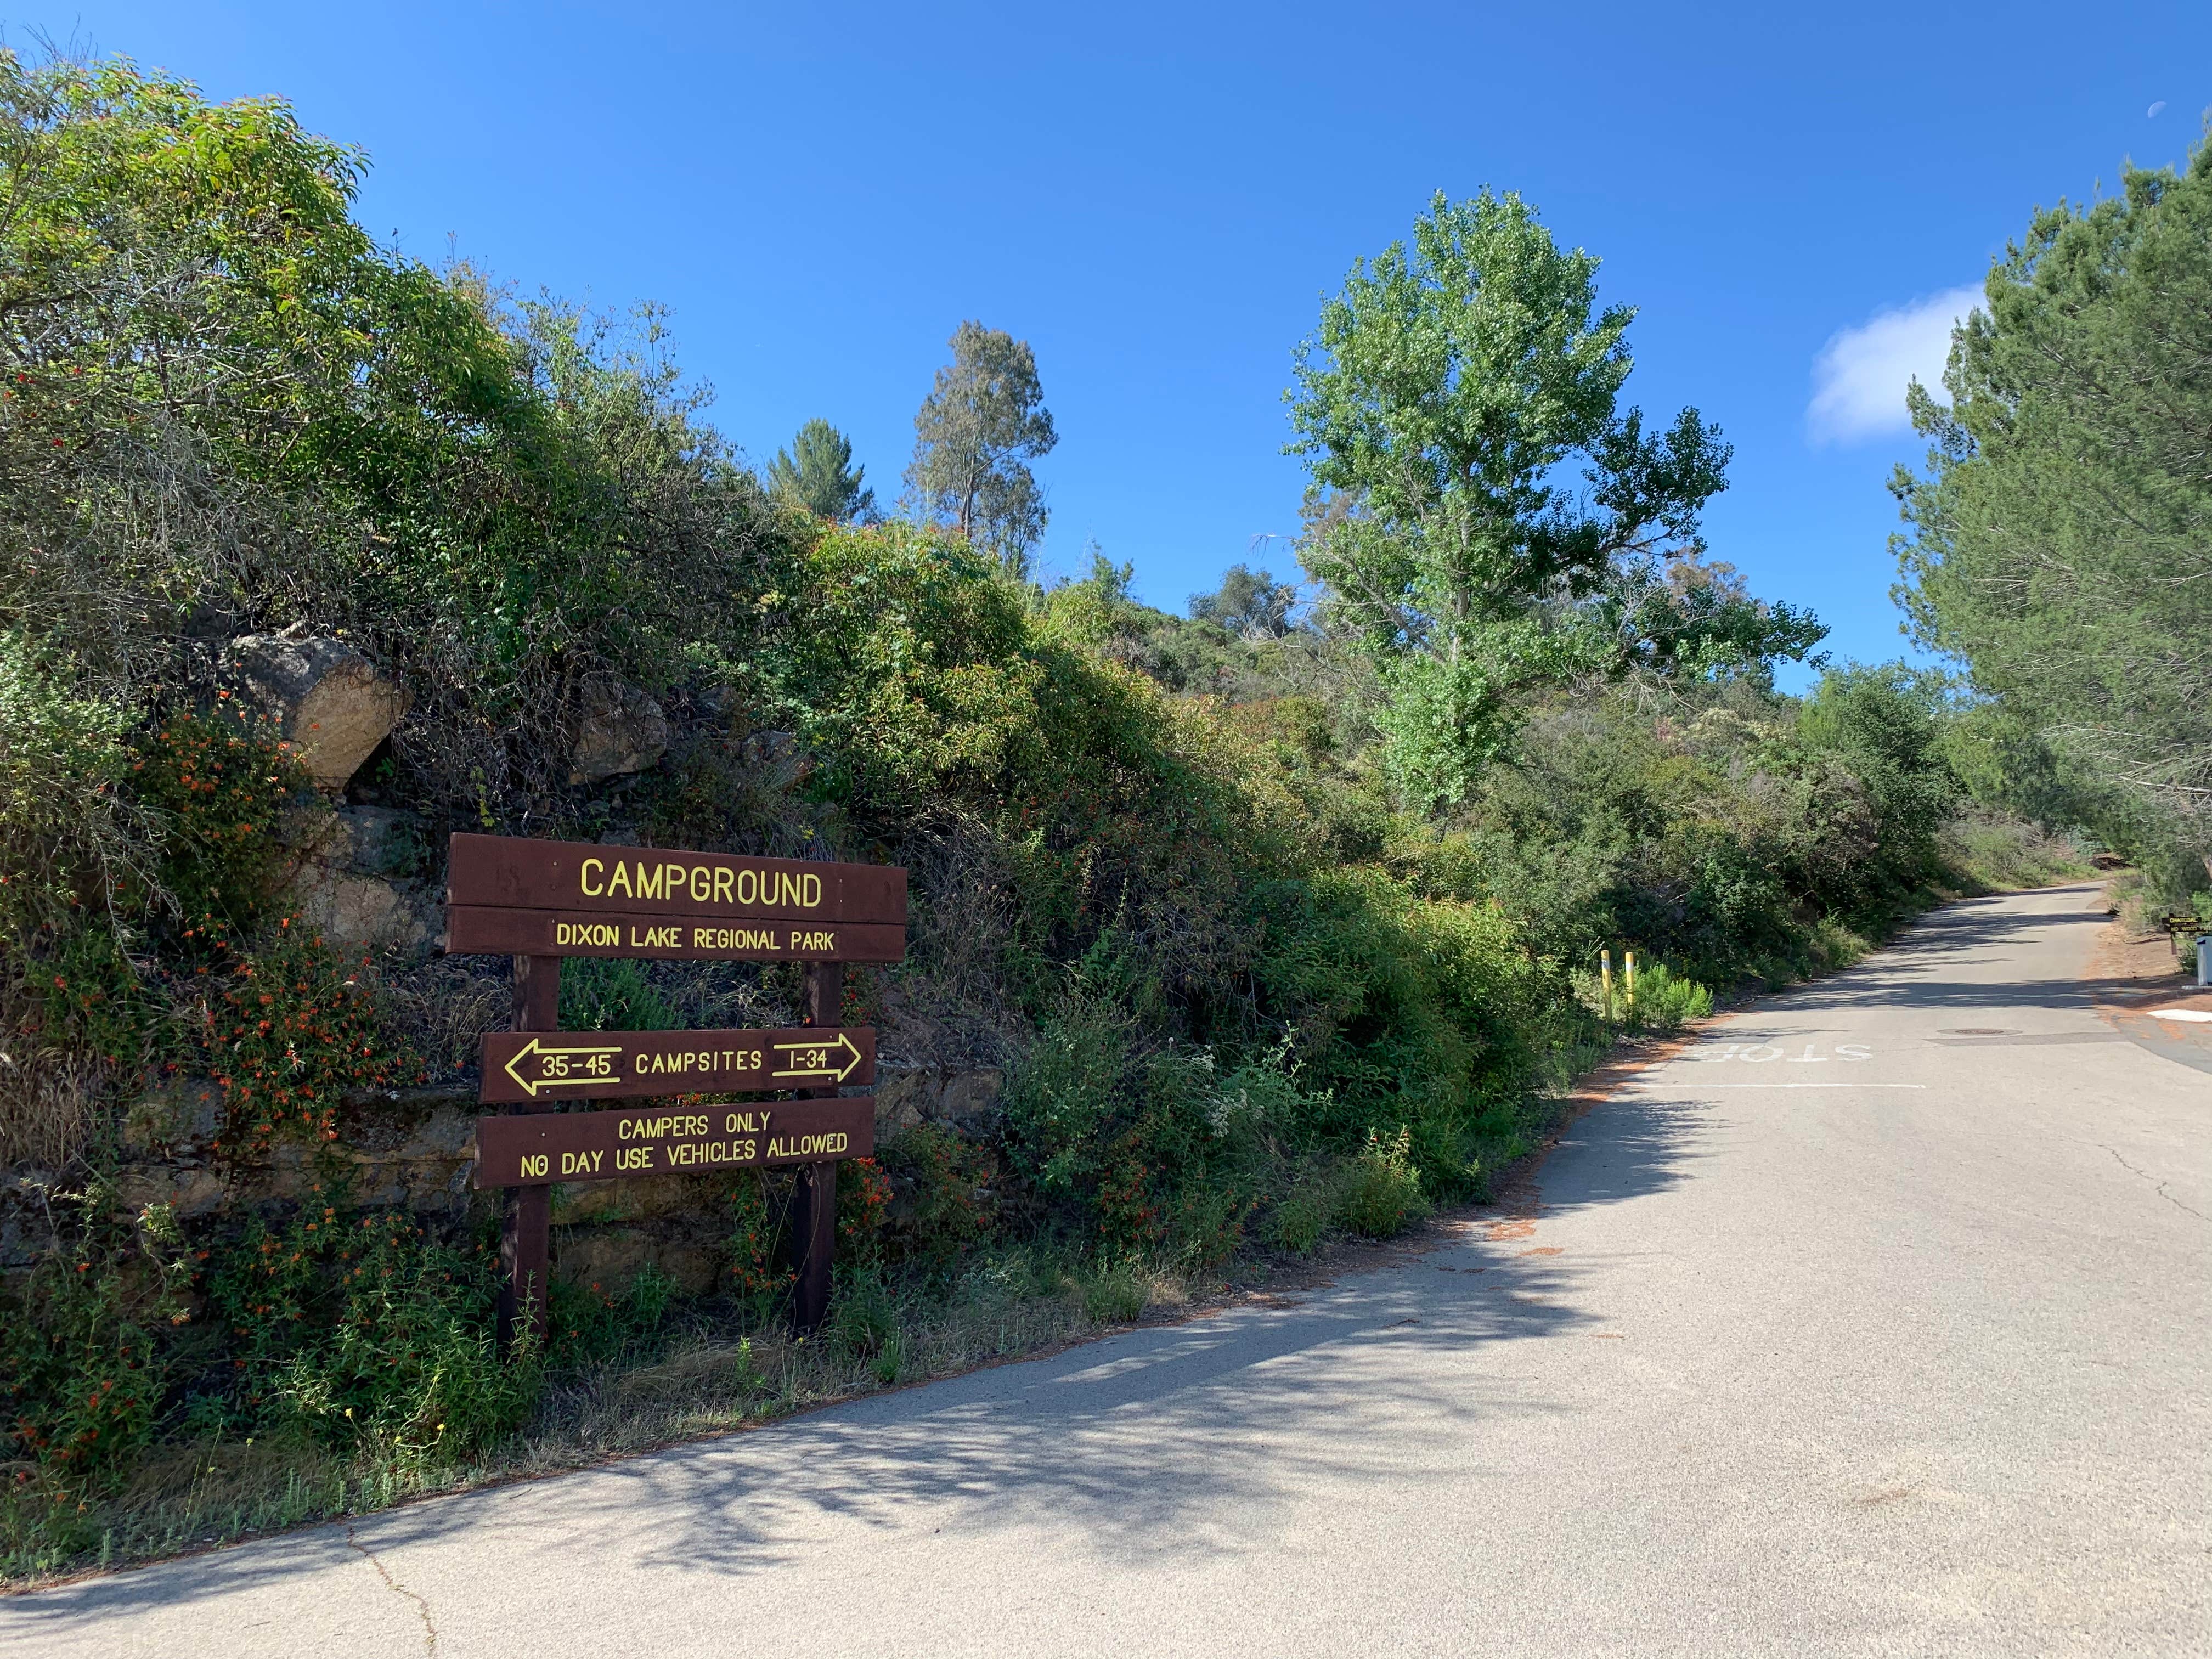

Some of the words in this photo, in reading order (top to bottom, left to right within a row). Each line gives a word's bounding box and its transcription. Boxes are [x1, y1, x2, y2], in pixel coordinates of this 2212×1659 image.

[580, 859, 822, 907] CAMPGROUND
[556, 923, 620, 947] DIXON
[630, 926, 682, 948] LAKE
[694, 928, 781, 950] REGIONAL
[791, 931, 835, 951] PARK
[541, 1054, 612, 1077] 35-45
[635, 1050, 762, 1074] CAMPSITES
[789, 1049, 827, 1070] 1-34
[1693, 1044, 1872, 1062] STOP
[618, 1115, 709, 1140] CAMPERS
[725, 1112, 771, 1133] ONLY
[520, 1154, 549, 1177] NO
[561, 1150, 604, 1175] DAY
[616, 1147, 654, 1170] USE
[666, 1139, 756, 1166] VEHICLES
[766, 1132, 848, 1158] ALLOWED
